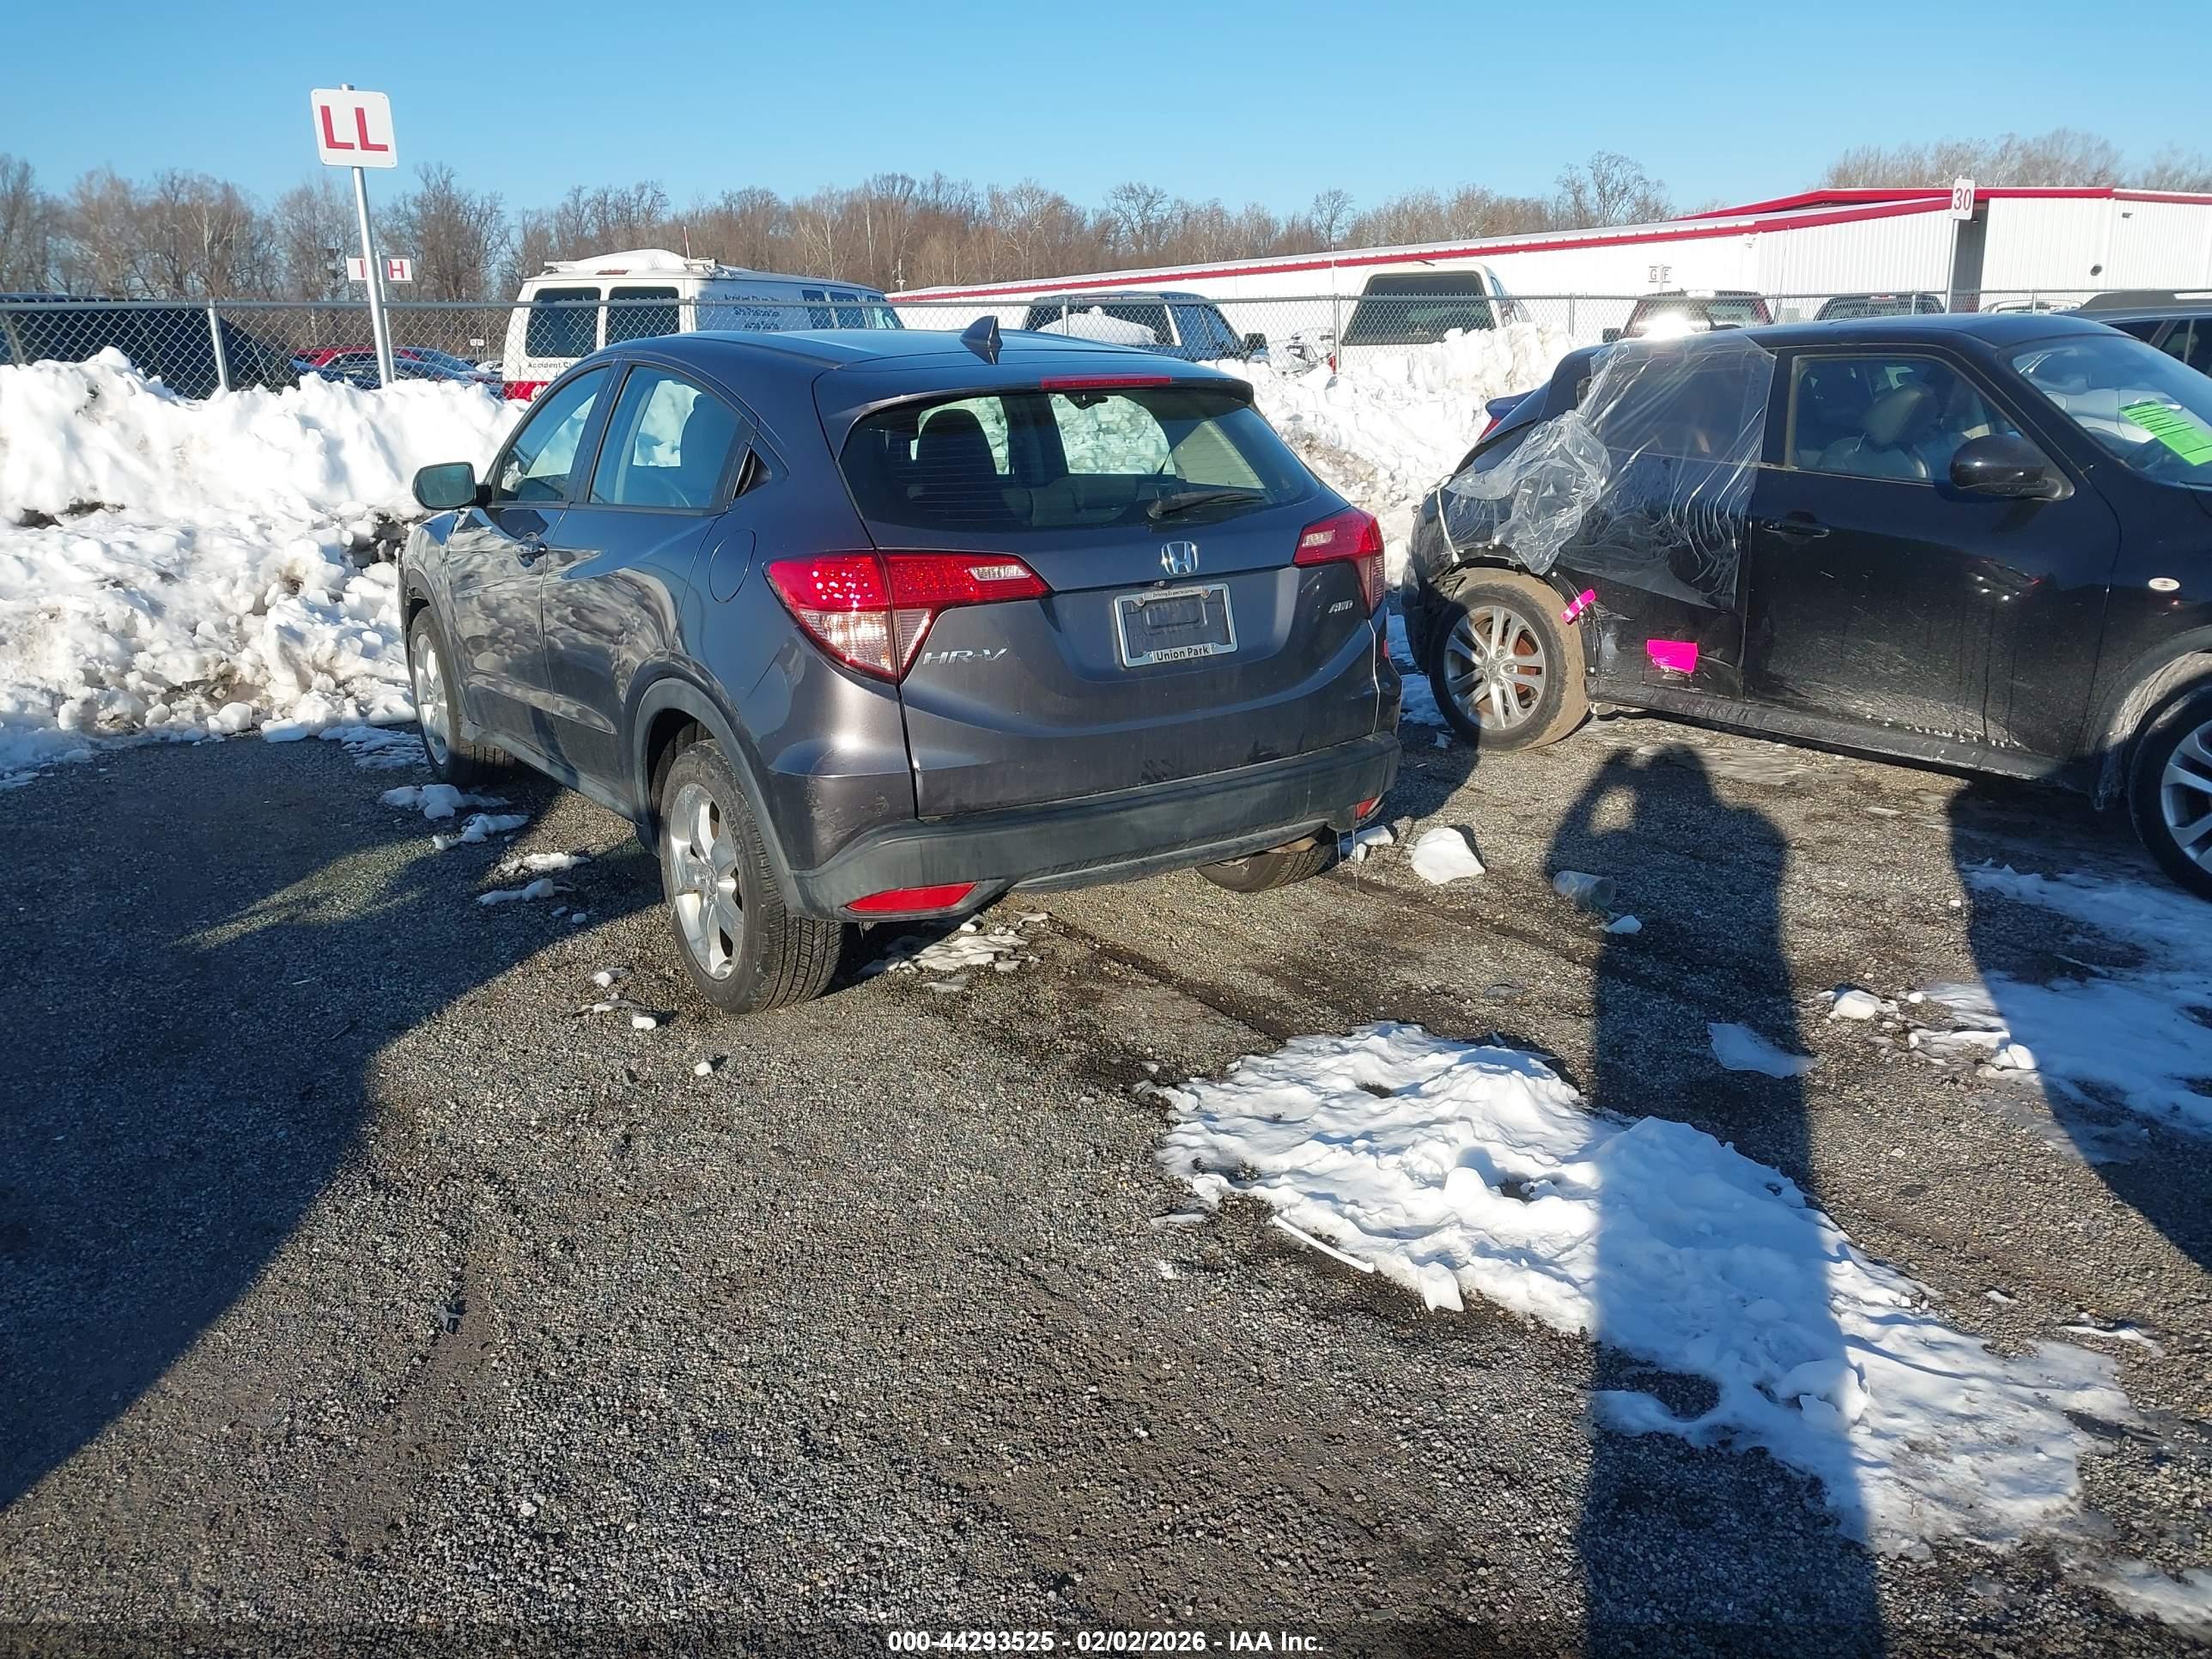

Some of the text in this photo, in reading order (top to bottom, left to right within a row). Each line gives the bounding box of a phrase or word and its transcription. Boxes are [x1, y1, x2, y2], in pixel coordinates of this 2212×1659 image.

[320, 105, 389, 152] LL
[1954, 187, 1972, 211] 30
[388, 260, 405, 279] H
[1650, 268, 1657, 281] G
[1663, 269, 1669, 281] F
[923, 647, 1007, 665] HR-V
[1156, 645, 1209, 661] Union Park
